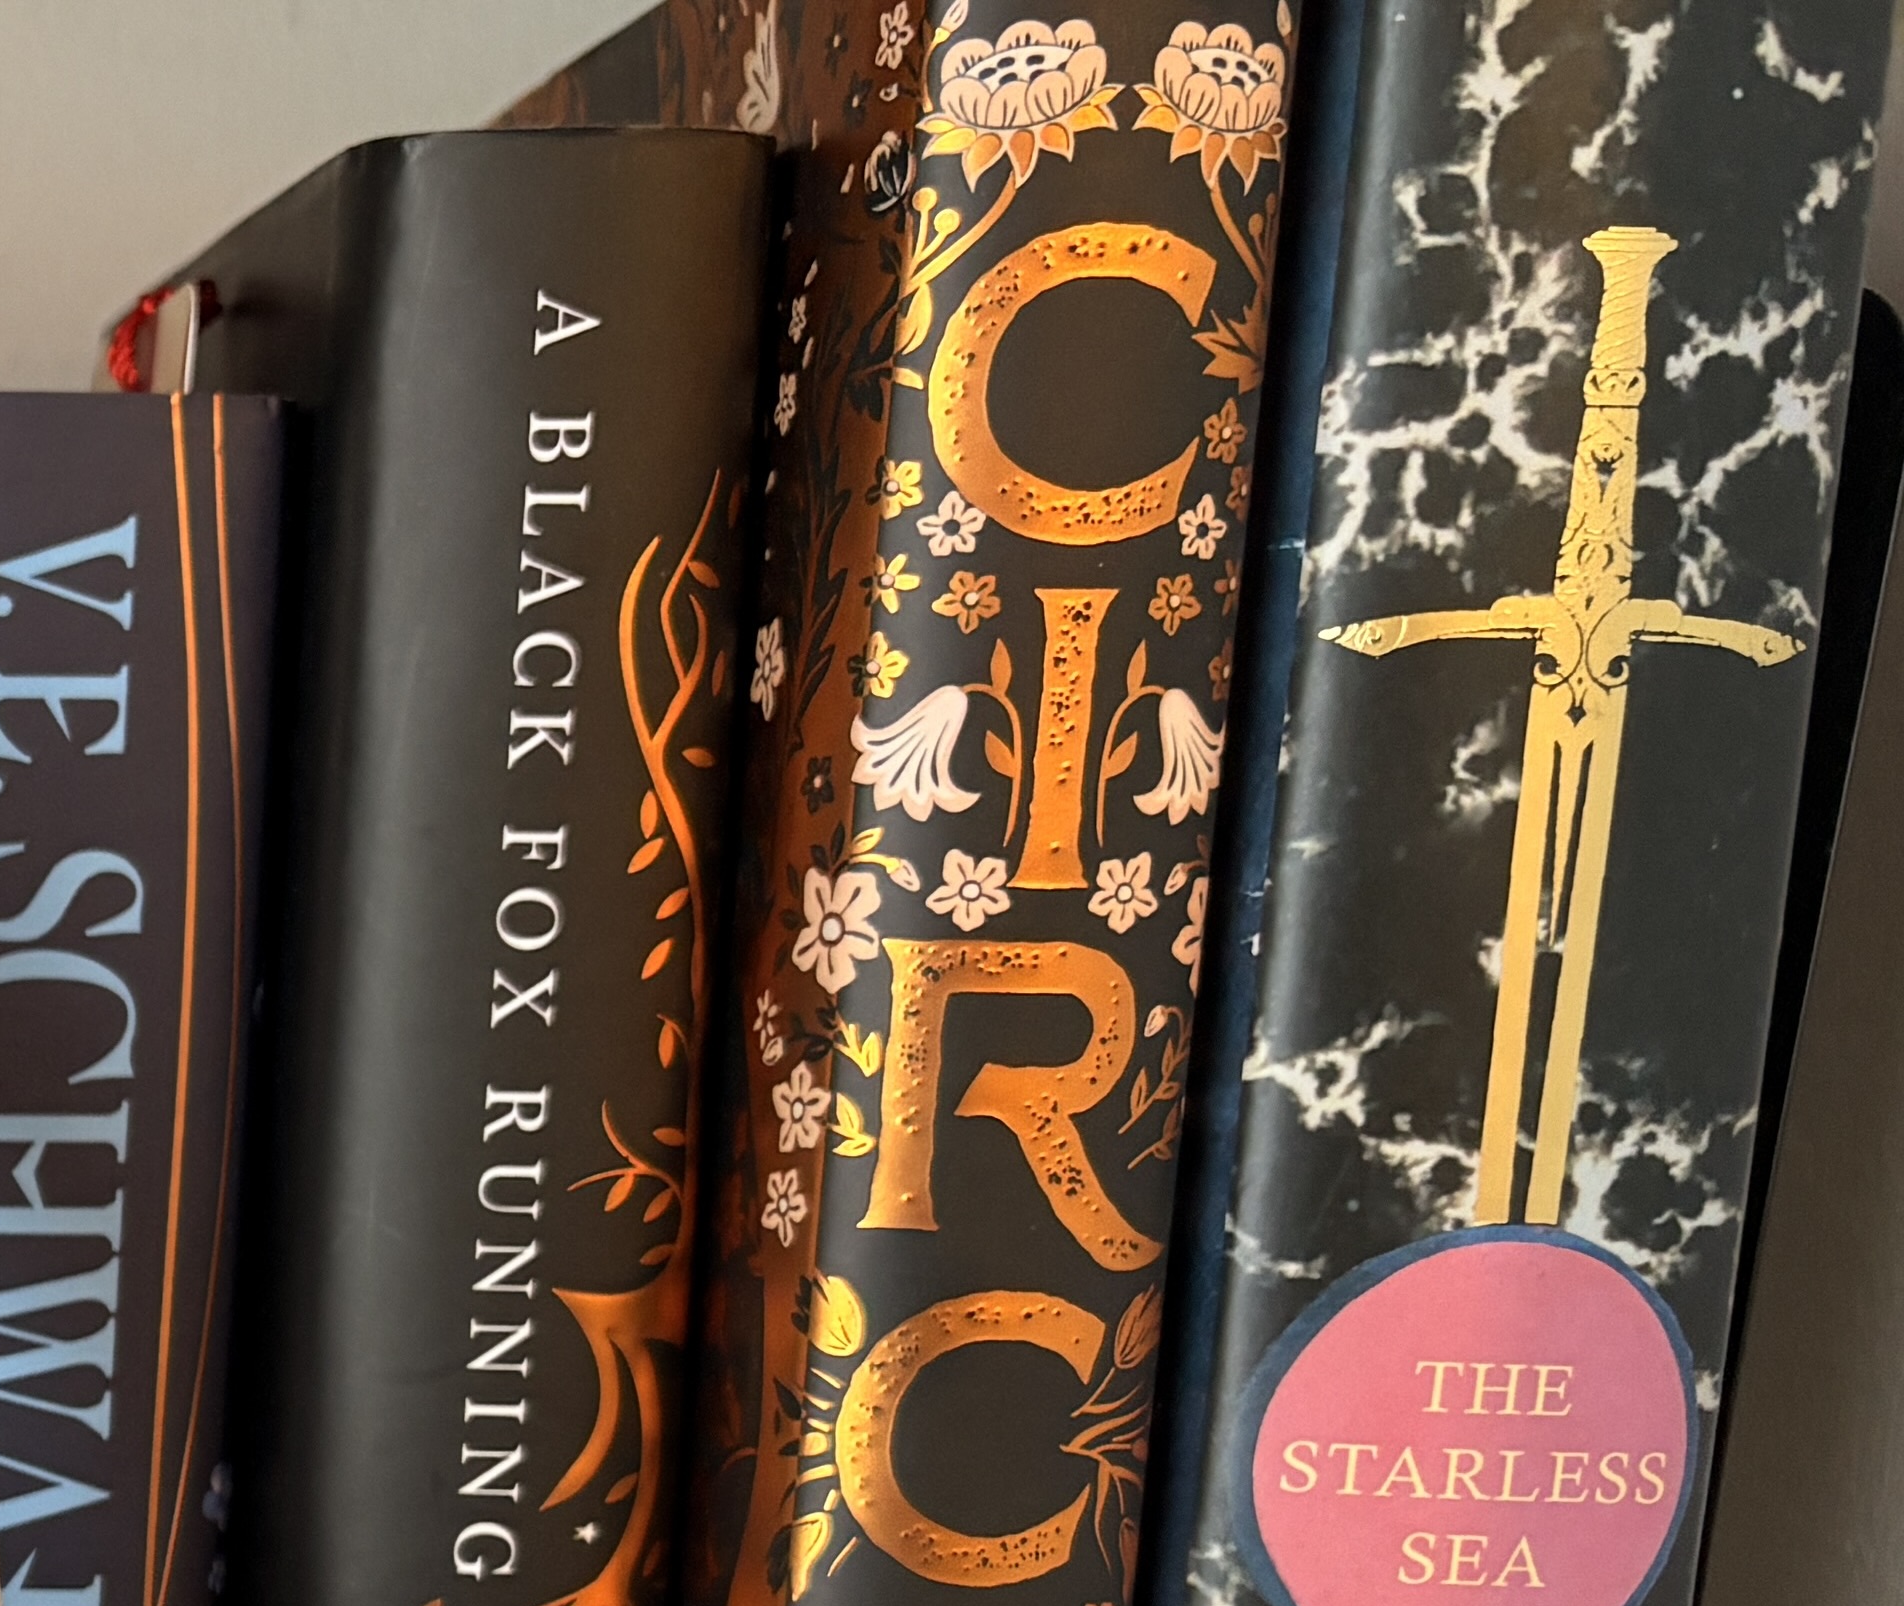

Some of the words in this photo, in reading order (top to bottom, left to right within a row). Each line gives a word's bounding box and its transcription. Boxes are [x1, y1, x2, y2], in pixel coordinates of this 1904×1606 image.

[533, 288, 603, 356] A
[508, 410, 596, 771] BLACK
[490, 824, 570, 1030] FOX
[452, 1083, 554, 1582] RUNNING
[1414, 1360, 1574, 1417] THE
[1278, 1440, 1668, 1505] STARLESS
[1396, 1531, 1547, 1589] SEA
